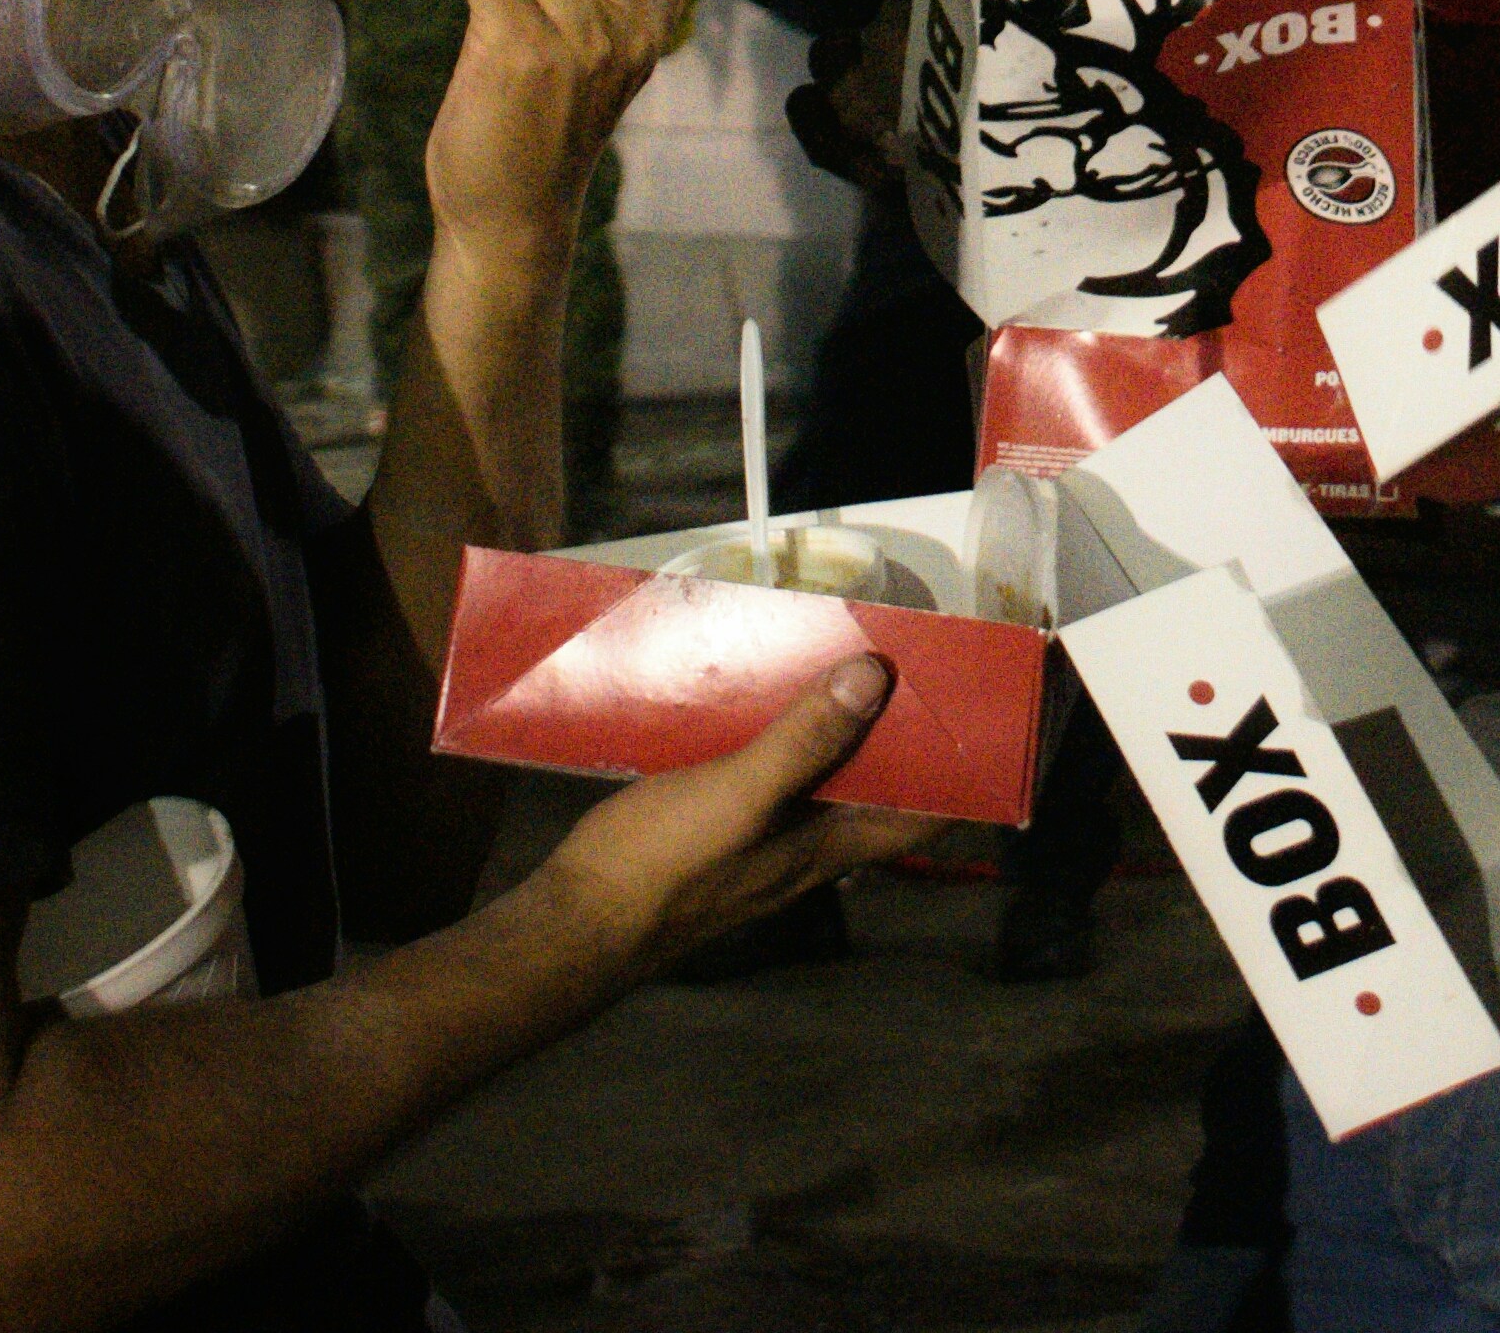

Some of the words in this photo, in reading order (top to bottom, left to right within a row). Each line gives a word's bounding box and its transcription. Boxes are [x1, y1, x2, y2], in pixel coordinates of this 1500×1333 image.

[1216, 2, 1357, 73] BOX
[1260, 426, 1360, 443] MBURGUES
[1165, 694, 1397, 982] BOX
